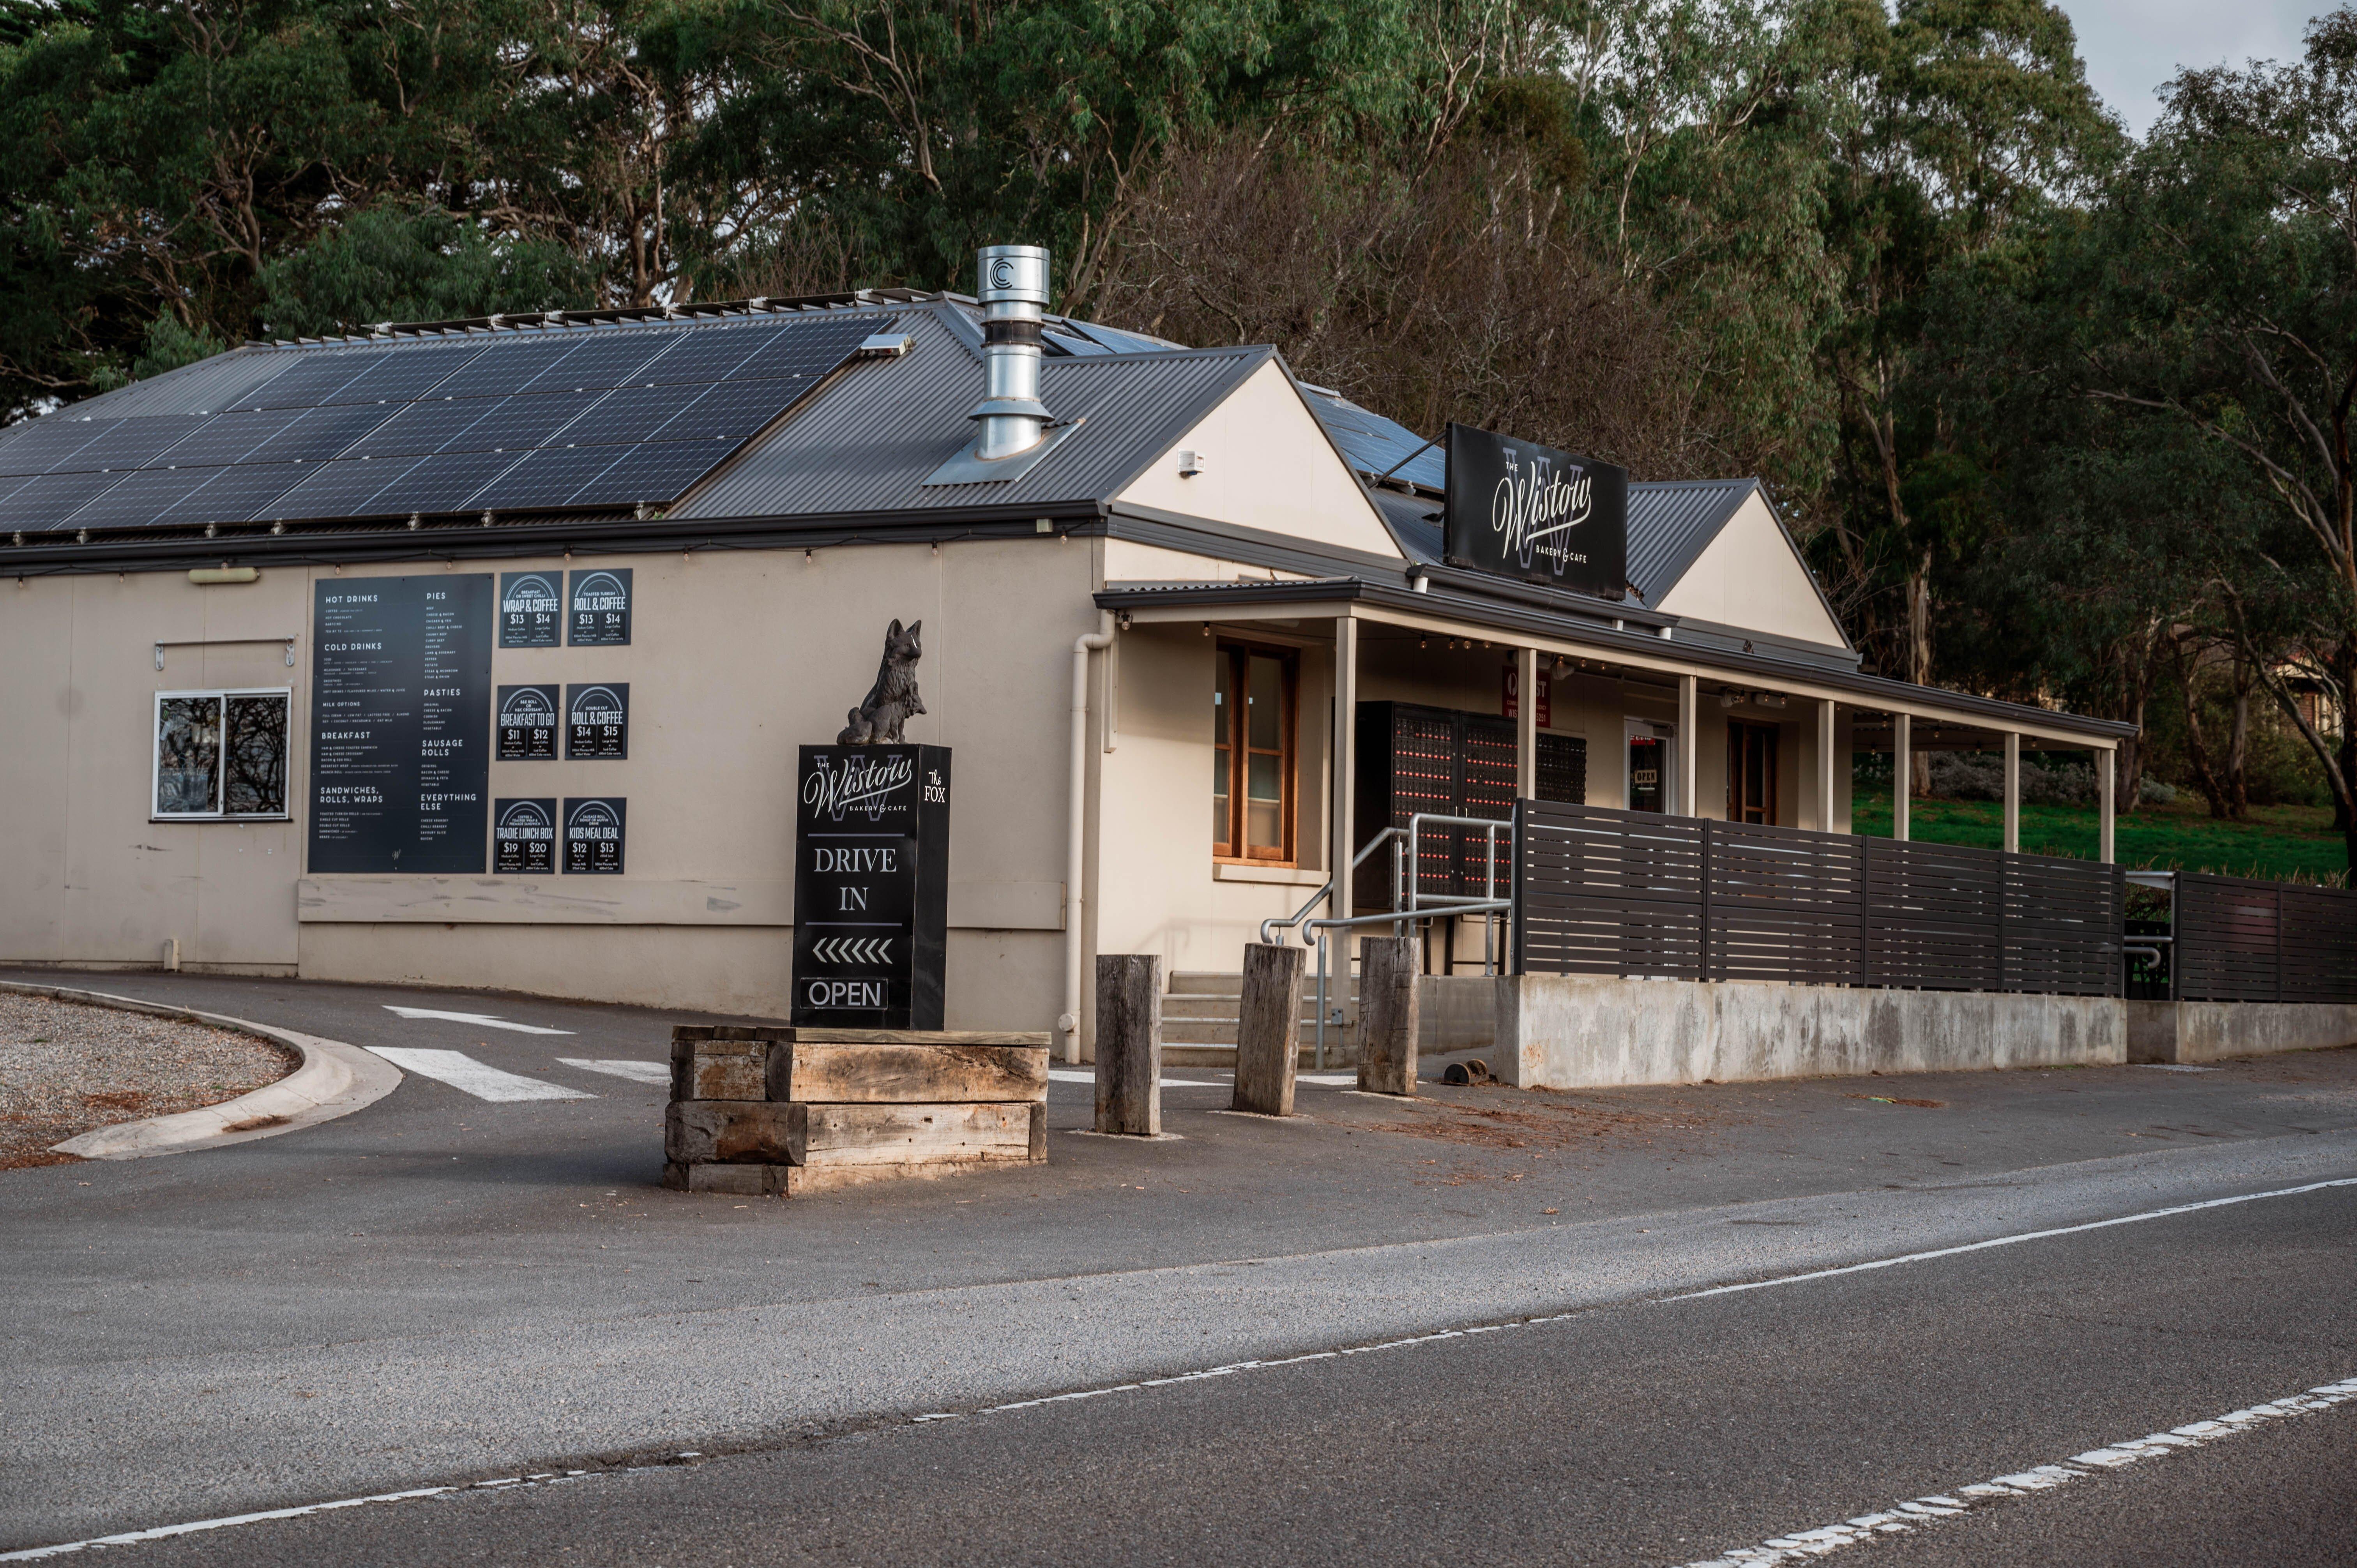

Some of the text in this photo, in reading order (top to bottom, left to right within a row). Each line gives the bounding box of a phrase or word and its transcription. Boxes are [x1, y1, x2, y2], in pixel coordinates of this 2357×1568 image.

[1506, 462, 1518, 471] THE
[1492, 461, 1591, 559] Wistow
[1536, 545, 1587, 563] BAKERY & CAFE
[347, 595, 378, 603] DRINKS
[574, 597, 625, 611] ROLL & COFFEE
[503, 599, 558, 613] WRAP & COFFEE
[510, 613, 524, 624] $13
[536, 613, 550, 624] $14
[579, 613, 593, 625] $13
[606, 613, 620, 624] $14
[501, 713, 554, 726] BREAKFAST TO GO
[572, 711, 622, 725] ROLL & COFFEE
[1536, 713, 1546, 722] 5251
[507, 729, 519, 740] $11
[534, 728, 548, 740] $12
[577, 726, 591, 737] $14
[604, 725, 617, 736] $15
[928, 769, 942, 786] The
[1637, 772, 1655, 781] OPEN
[804, 758, 912, 818] Wistow
[924, 786, 945, 803] FOX
[879, 804, 886, 812] &
[496, 828, 553, 839] TRADIE LUNCH BOX
[569, 827, 618, 839] KIDS MEAL DEAL
[504, 842, 518, 853] $19
[529, 842, 546, 853] $20
[572, 841, 587, 853] $12
[600, 842, 614, 853] $13
[814, 848, 897, 872] DRIVE
[839, 887, 869, 911] IN
[808, 981, 881, 1006] OPEN
